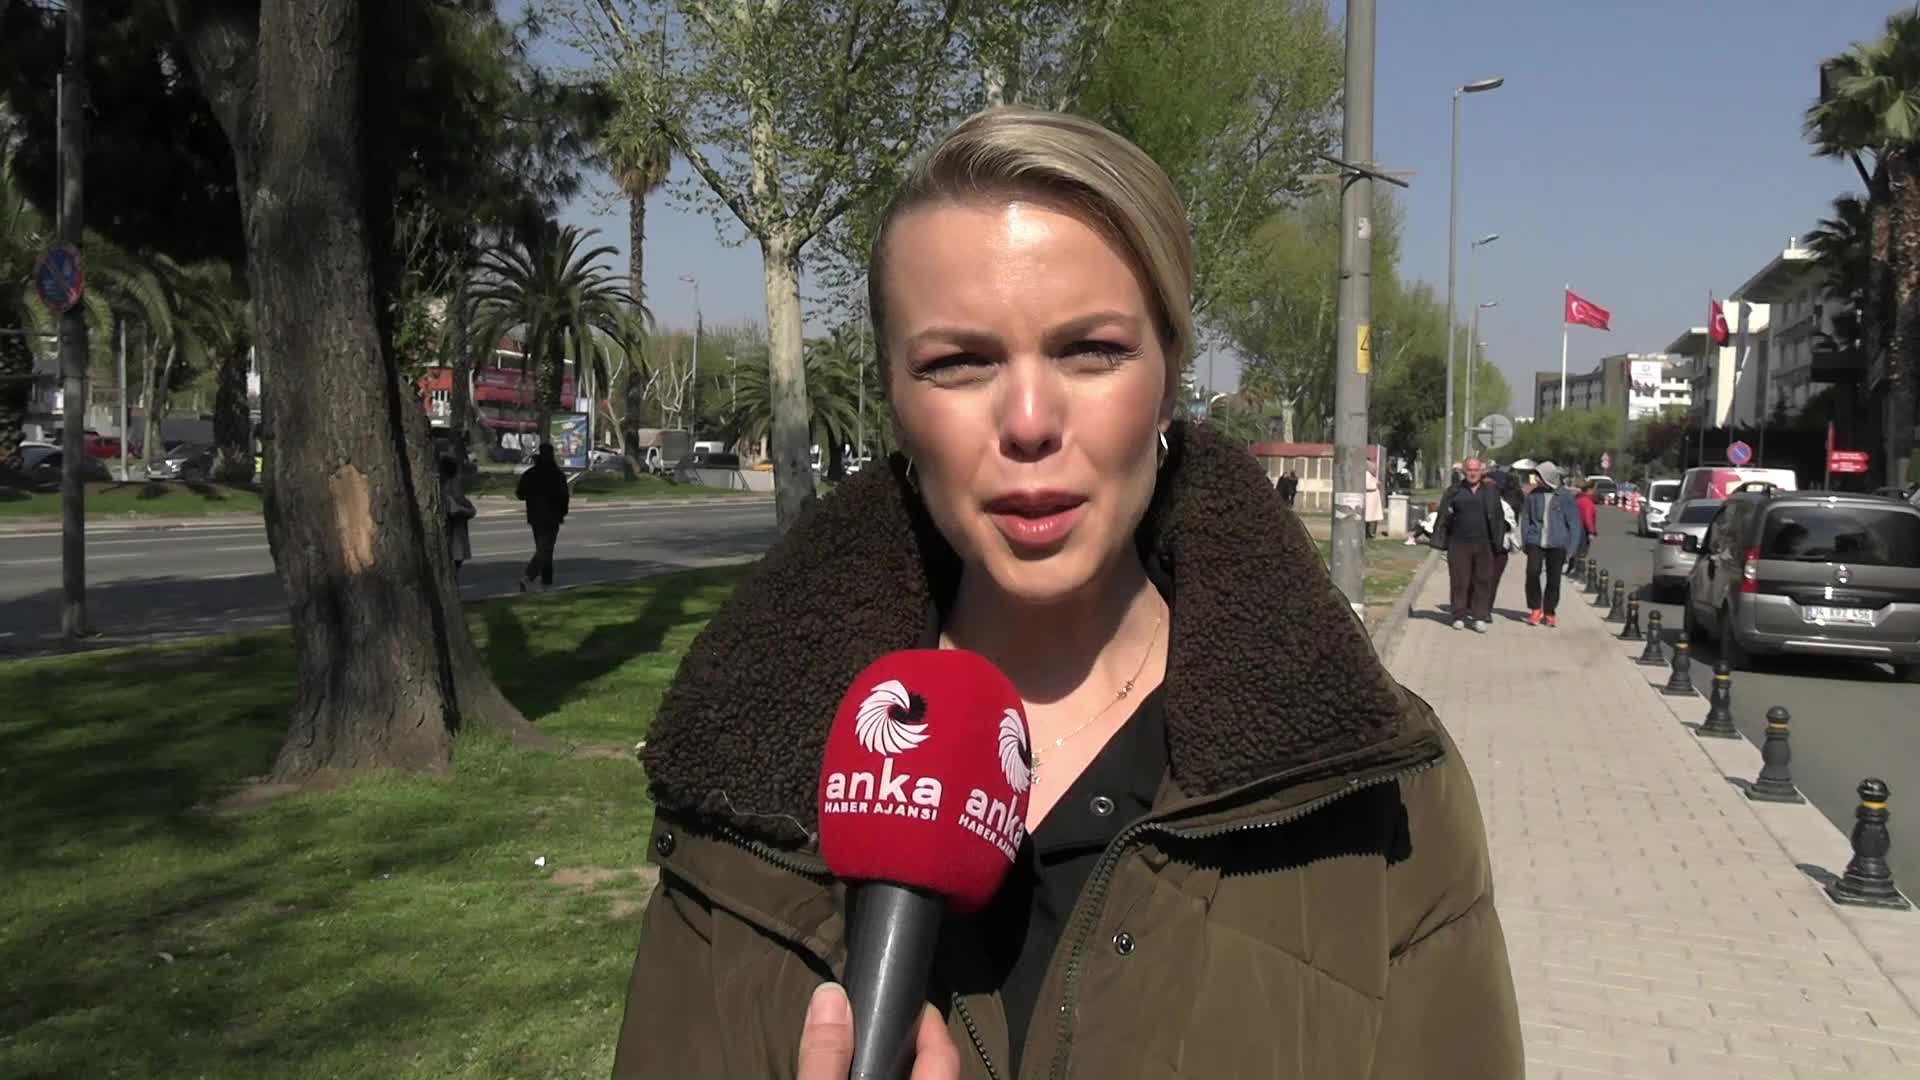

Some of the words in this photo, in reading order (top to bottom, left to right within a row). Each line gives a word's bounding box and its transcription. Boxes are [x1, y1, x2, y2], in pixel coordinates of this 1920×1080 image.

[825, 758, 942, 807] anka
[824, 802, 868, 813] HABER
[873, 803, 938, 821] AJANSI
[958, 814, 996, 844] HABER
[965, 788, 1024, 851] anka
